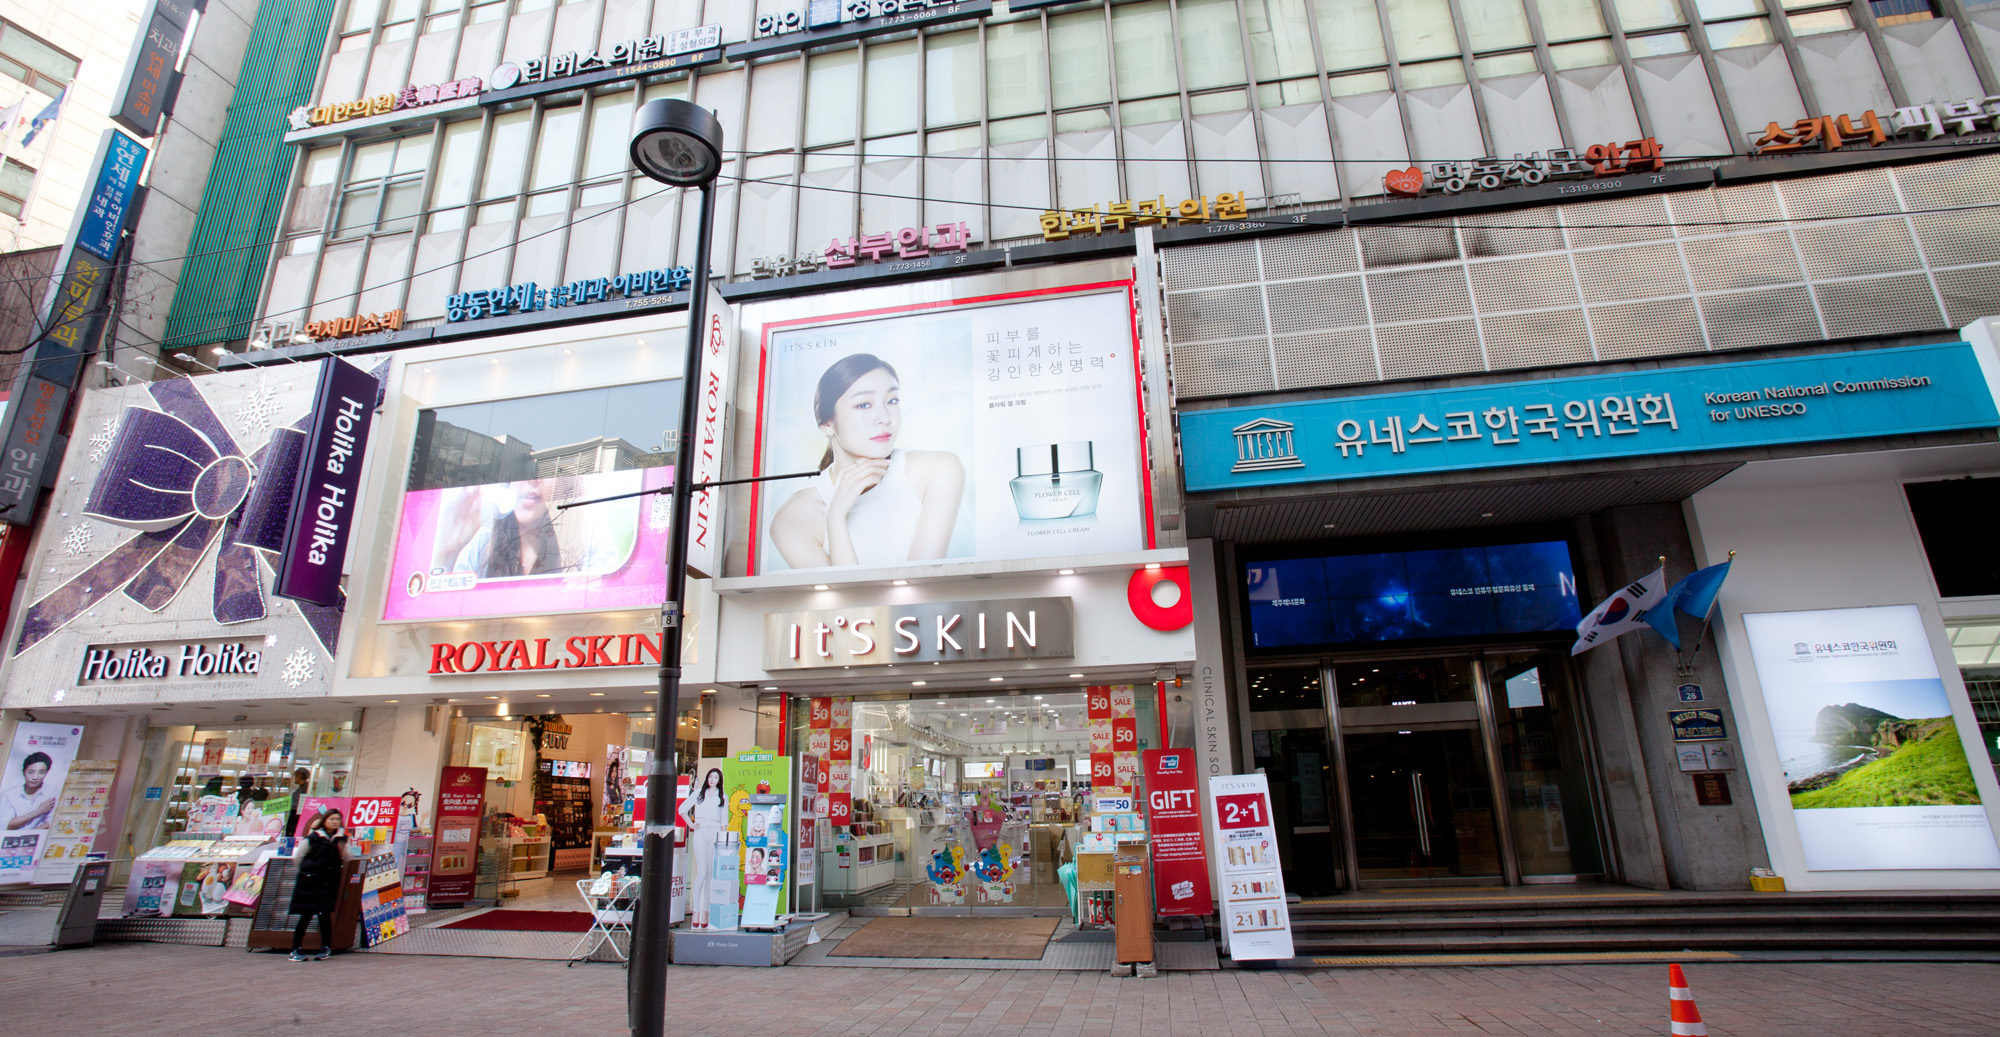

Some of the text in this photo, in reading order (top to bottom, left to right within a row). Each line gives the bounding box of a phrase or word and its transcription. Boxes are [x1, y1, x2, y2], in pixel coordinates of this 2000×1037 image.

[948, 5, 961, 14] 8F
[149, 28, 177, 57] 치과
[617, 53, 704, 76] T.1544-0890 8F
[1755, 110, 1886, 154] 스키니
[1585, 137, 1664, 178] 안과
[1650, 175, 1667, 185] 7F
[1039, 191, 1247, 241] 한피부과 의원
[1292, 215, 1307, 223] 3F
[824, 221, 971, 269] 산부인과
[888, 256, 967, 272] T.773-1456 2F
[445, 281, 536, 322] 명동연세
[303, 308, 402, 343] 연세미소래
[986, 327, 1040, 344] 피부를
[1704, 375, 1932, 405] Korean National Commission
[702, 369, 719, 466] ROYAL
[1709, 402, 1807, 422] for UNESCO
[327, 395, 364, 476] Holika
[1334, 392, 1679, 458] 유네스코한국위원회
[1237, 432, 1294, 461] UNESCO
[0, 448, 40, 501] 안과
[695, 471, 711, 551] SKIN
[308, 482, 347, 567] Holika
[666, 615, 671, 625] 8
[893, 609, 1037, 653] SKIN
[428, 632, 664, 674] ROYAL SKIN
[1814, 640, 1898, 654] 유네스코한국위원회
[83, 643, 263, 681] Holika Holika
[1202, 666, 1215, 723] CLINICAL
[1686, 692, 1697, 700] 26
[834, 709, 849, 717] SALE
[811, 741, 827, 749] SALE
[1207, 725, 1218, 748] SKIN
[739, 754, 774, 762] SESAME STREET
[803, 760, 817, 779] 2+1
[1117, 765, 1135, 773] SALE
[832, 773, 849, 781] SALE
[1150, 789, 1195, 810] GIFT
[1224, 801, 1261, 823] 2+1
[801, 824, 815, 843] 2+1
[672, 876, 684, 885] PEN
